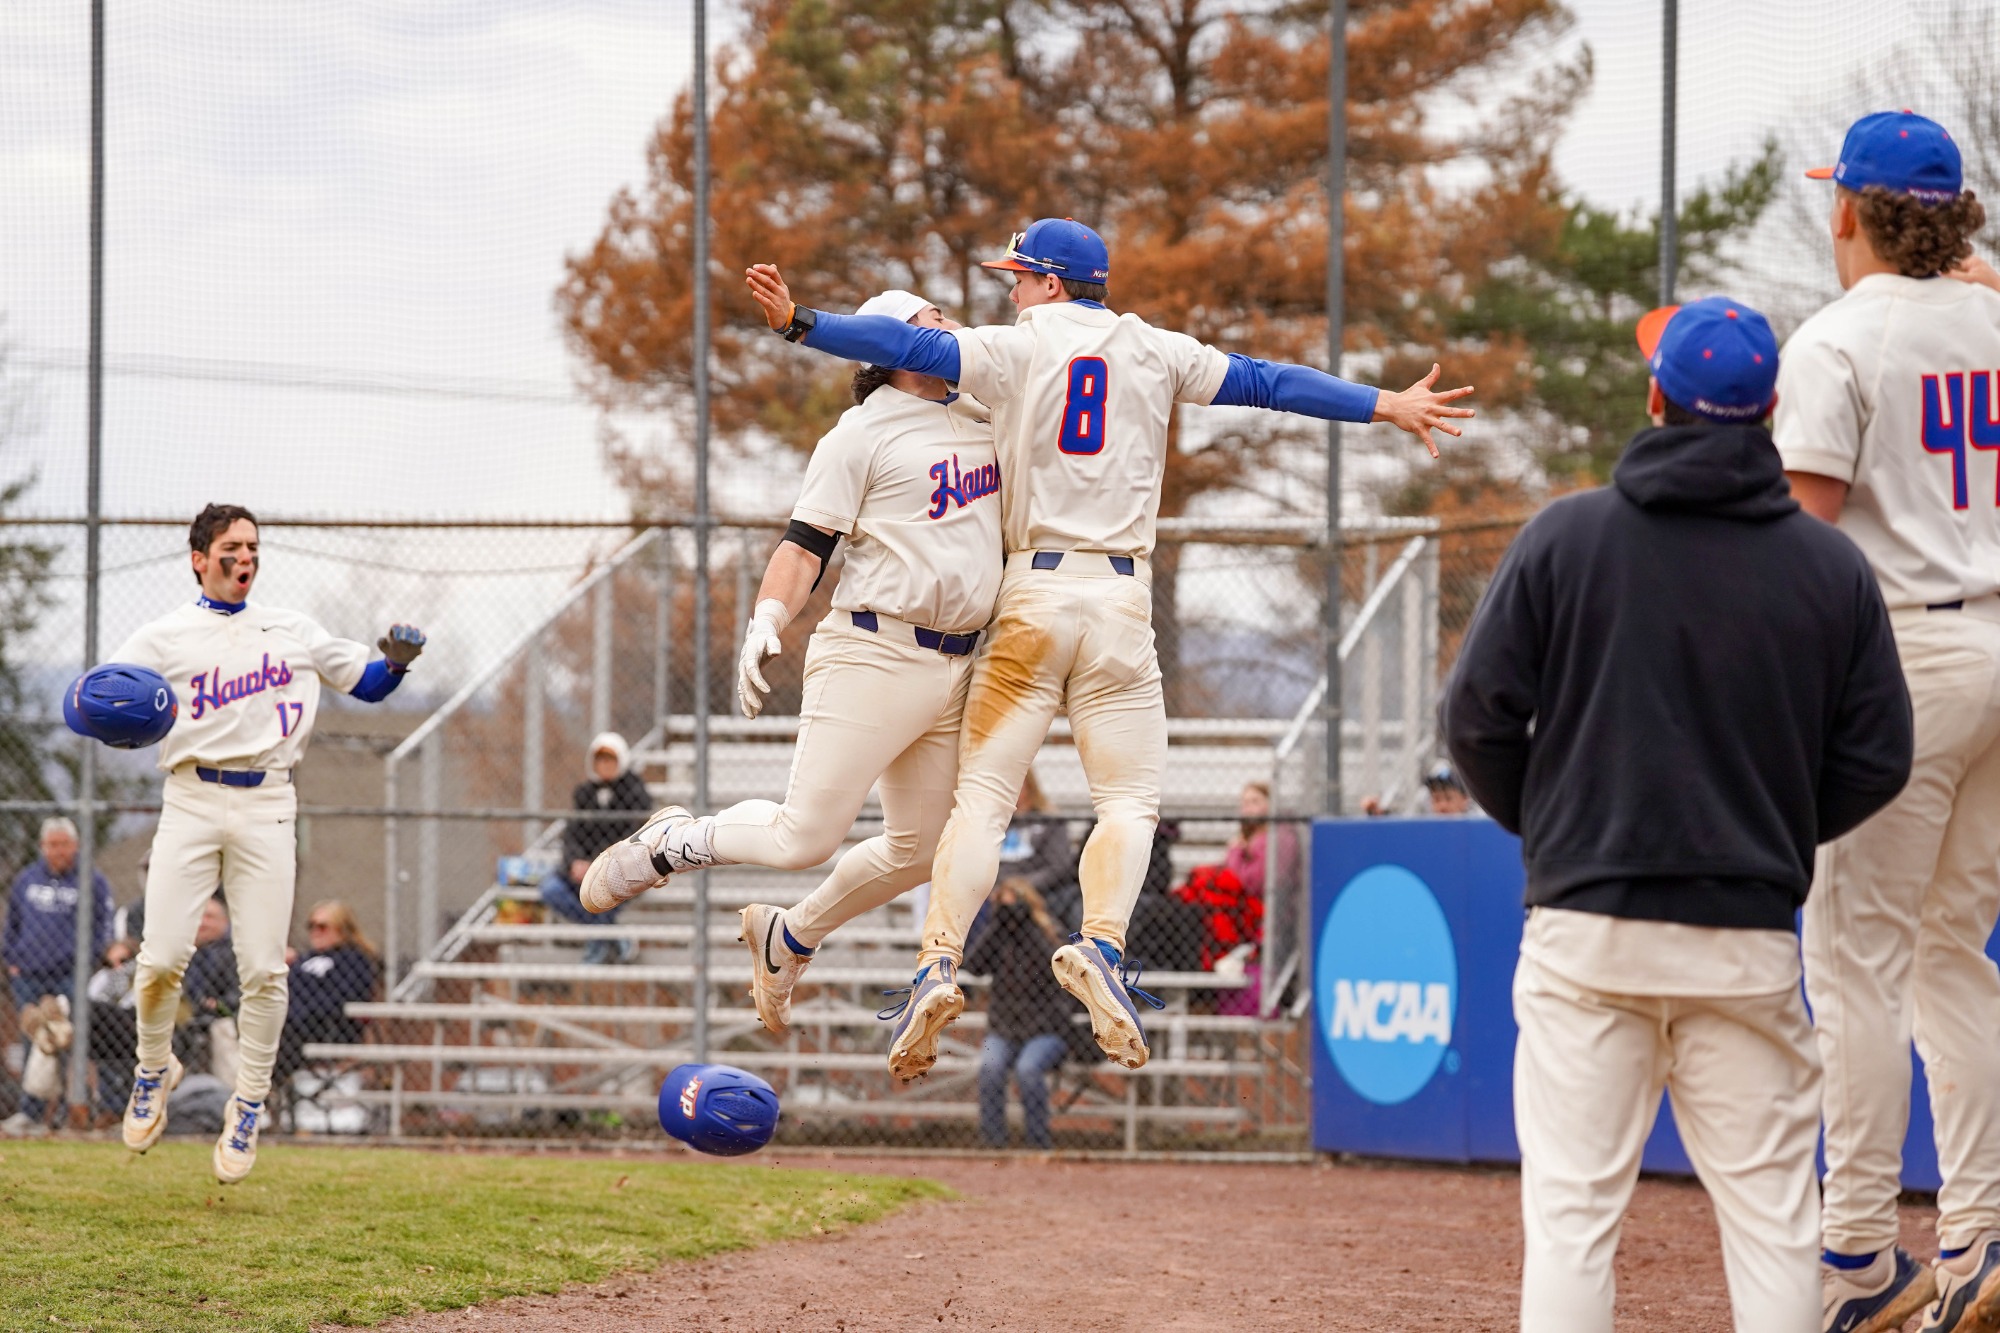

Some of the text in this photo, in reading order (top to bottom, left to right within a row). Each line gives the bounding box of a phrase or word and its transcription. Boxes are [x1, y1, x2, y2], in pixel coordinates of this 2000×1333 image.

[1058, 356, 1108, 455] 8
[1921, 369, 2000, 511] 44
[928, 453, 999, 520] Haw
[191, 652, 293, 720] Hawks
[276, 702, 303, 738] 17
[1331, 979, 1451, 1046] NCAA
[679, 1075, 703, 1120] NP
